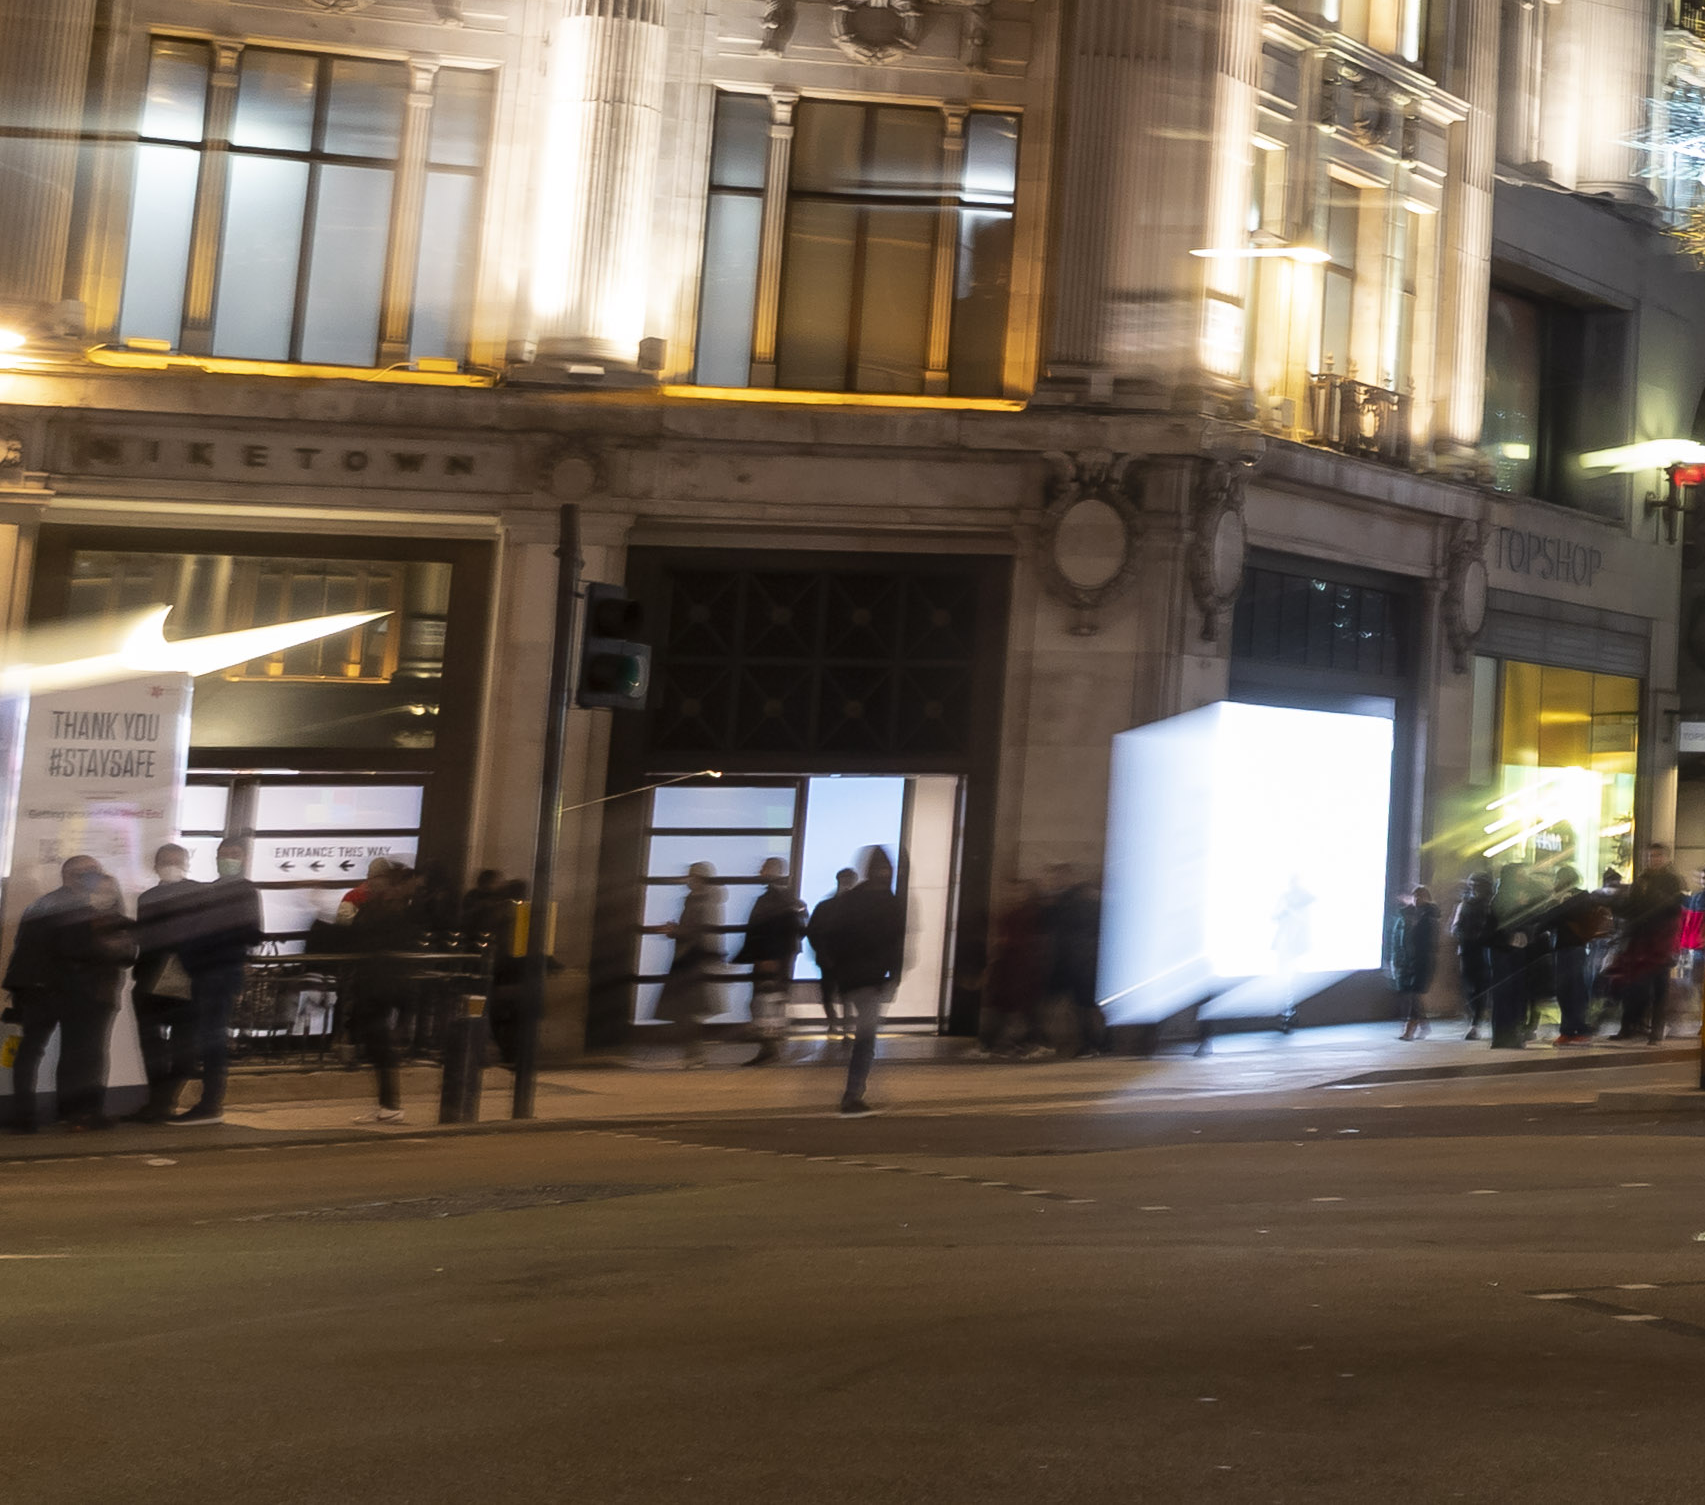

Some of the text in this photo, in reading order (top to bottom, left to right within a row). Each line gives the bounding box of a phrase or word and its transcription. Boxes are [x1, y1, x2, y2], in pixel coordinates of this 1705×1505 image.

[90, 435, 474, 476] NIKETOWN
[1497, 526, 1604, 588] TOPSHOP
[52, 710, 160, 742] THANK YOU
[49, 747, 156, 779] #STAYSAFE
[275, 847, 391, 858] ENTRANCE THIS WAY
